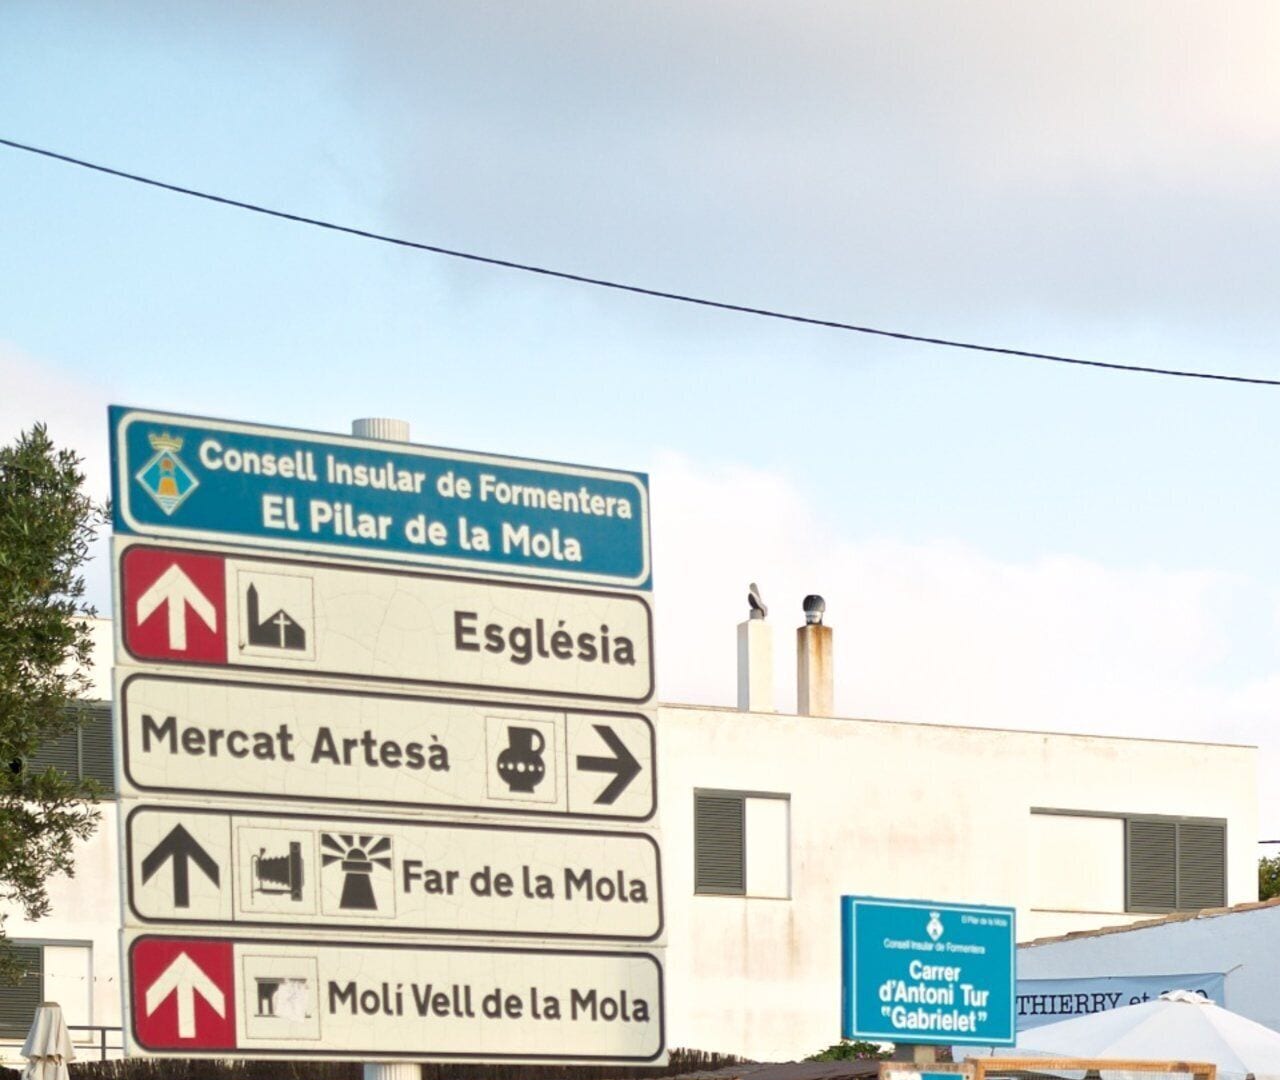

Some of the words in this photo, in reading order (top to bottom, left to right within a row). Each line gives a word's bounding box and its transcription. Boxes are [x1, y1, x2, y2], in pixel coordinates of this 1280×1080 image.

[199, 440, 317, 482] Consell
[327, 456, 425, 494] Insular
[436, 471, 471, 499] de
[480, 475, 632, 520] Formentera
[262, 496, 299, 531] El
[310, 502, 391, 540] Pilar
[405, 513, 447, 546] de
[459, 521, 490, 552] la
[502, 526, 581, 563] Mola
[453, 609, 636, 666] Església
[141, 715, 295, 762] Mercat
[311, 727, 450, 772] Artesà
[402, 860, 459, 896] Far
[470, 864, 513, 898] de
[522, 868, 554, 899] la
[564, 868, 648, 904] Mola
[883, 938, 910, 949] Consell
[911, 940, 934, 951] Insular
[935, 942, 945, 952] de
[946, 943, 985, 954] Formentera
[909, 960, 961, 982] Carrer
[327, 981, 403, 1017] Molí
[412, 984, 471, 1018] Vell
[481, 987, 522, 1019] de
[531, 989, 560, 1020] la
[570, 989, 650, 1022] Mola
[879, 980, 954, 1005] d'Antoni
[960, 984, 990, 1007] Tur
[1016, 992, 1123, 1016] THIERRY
[1129, 992, 1150, 1006] et
